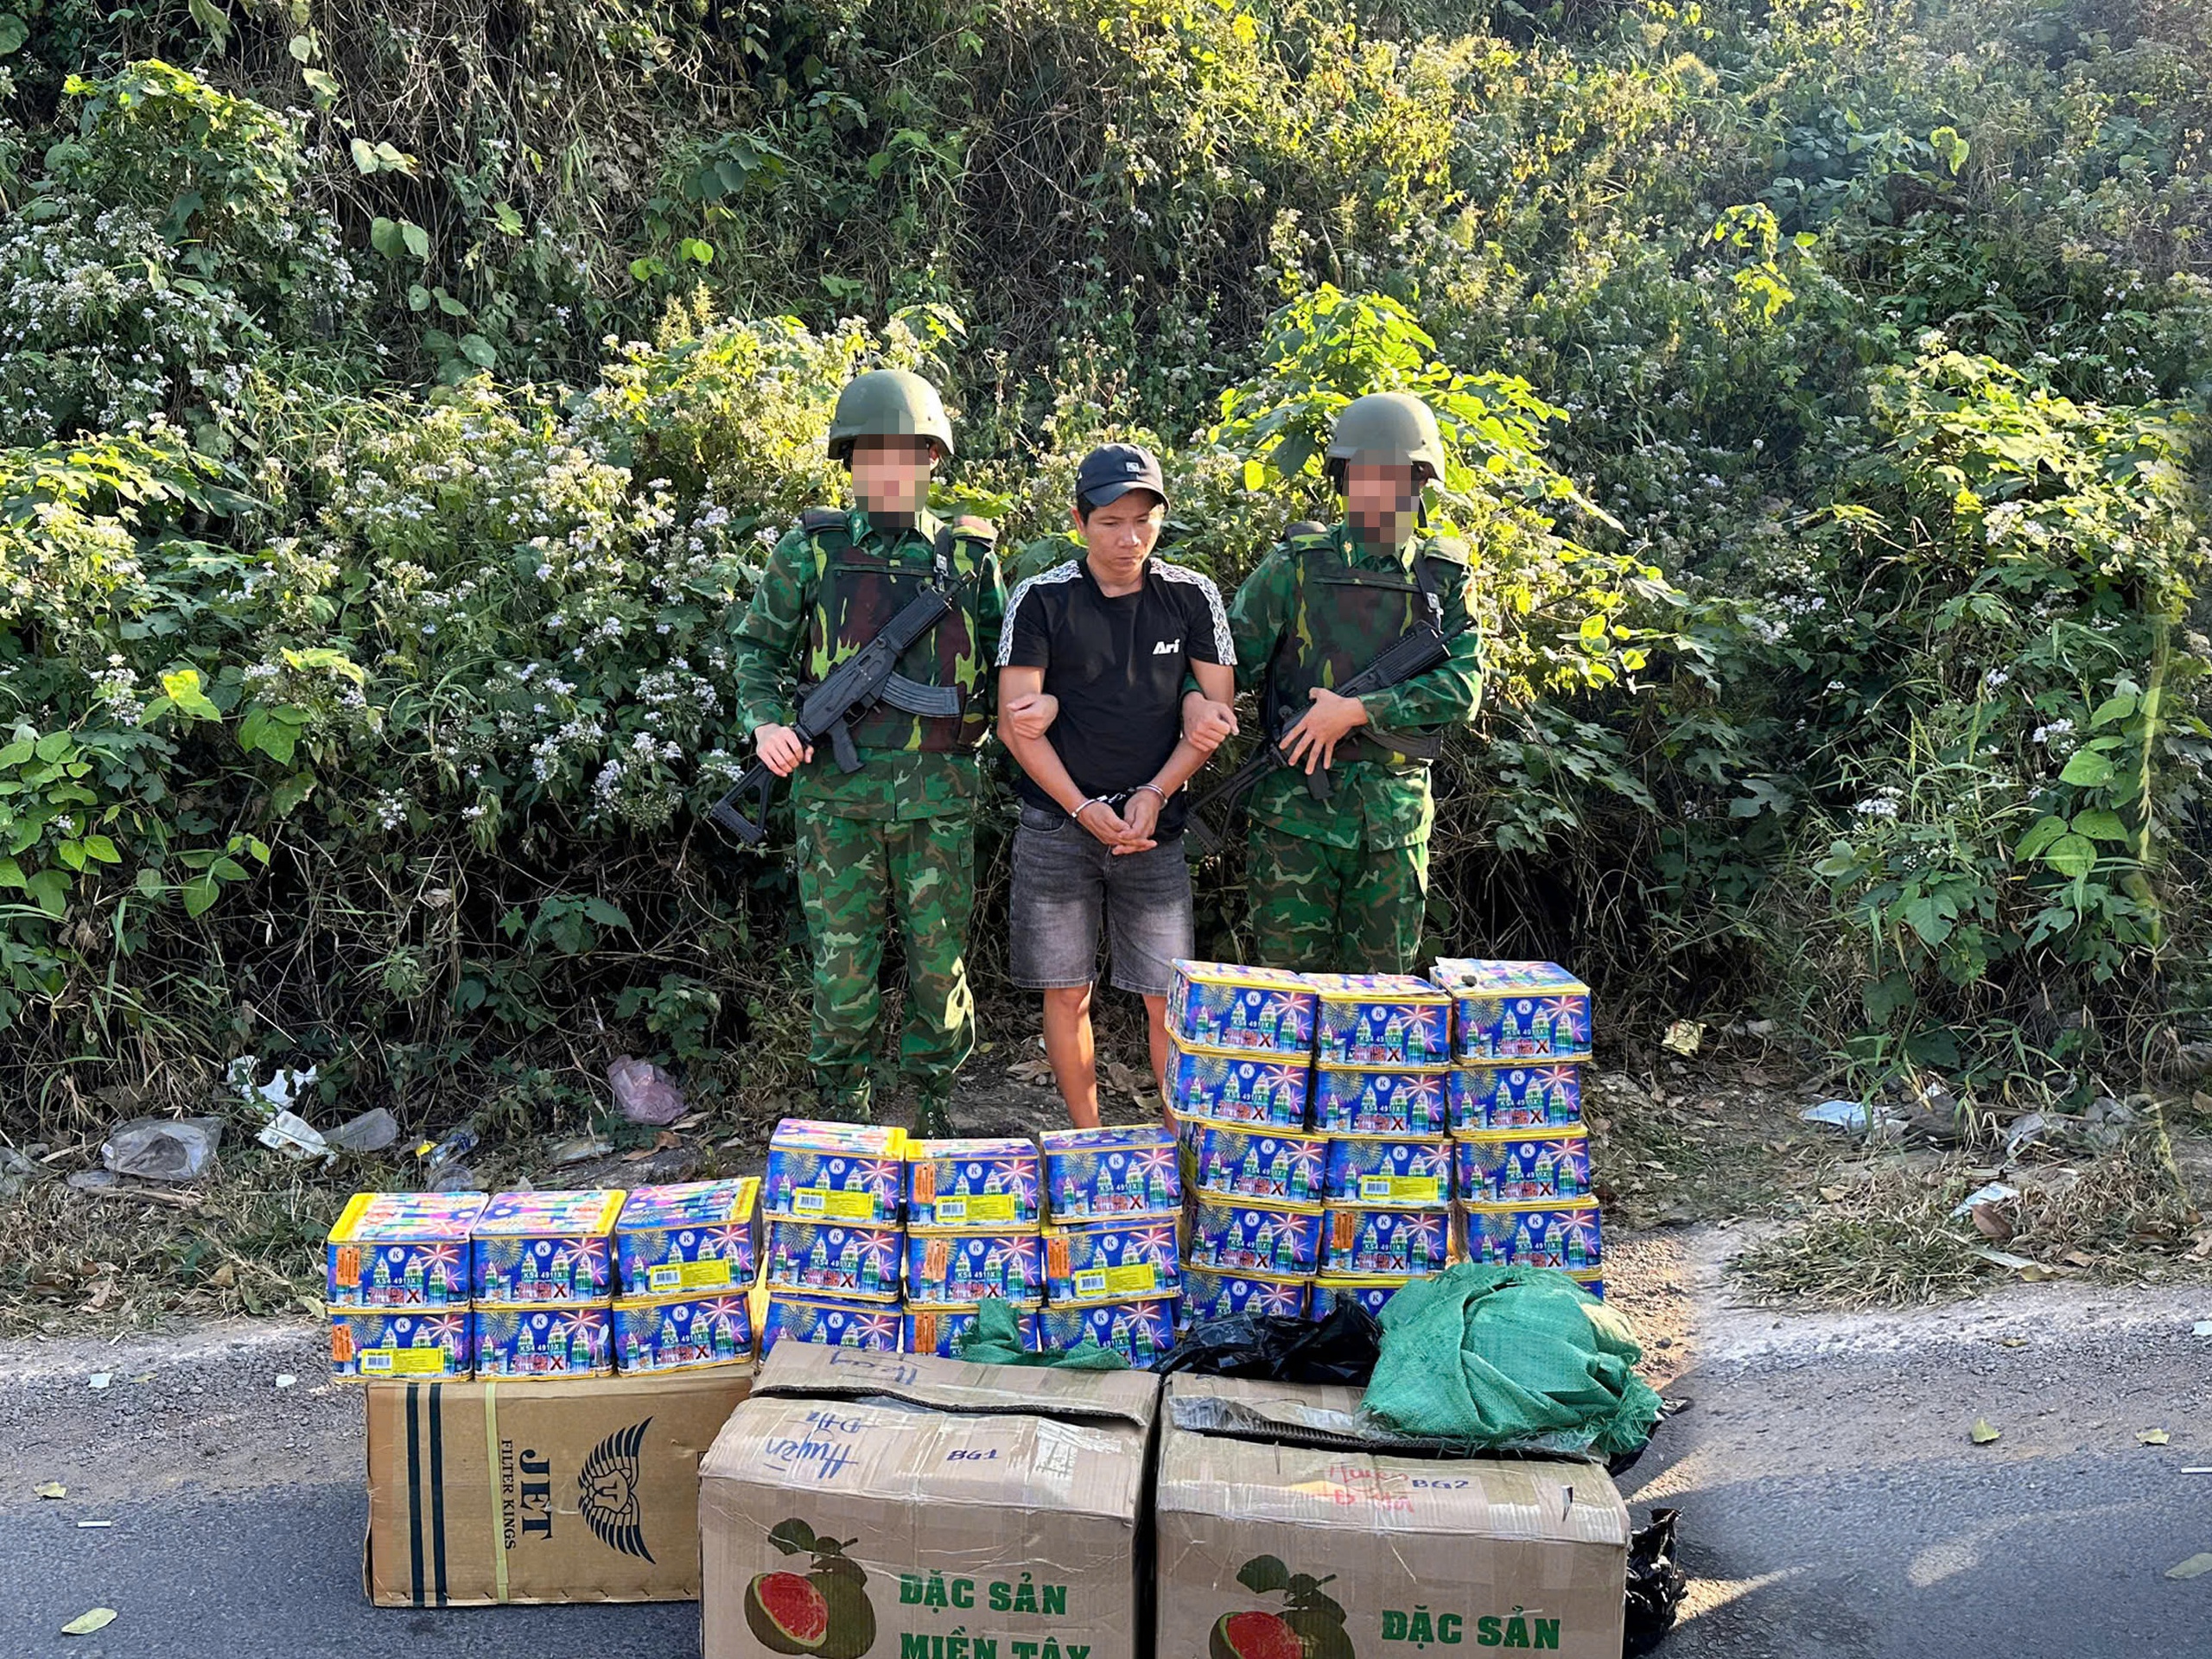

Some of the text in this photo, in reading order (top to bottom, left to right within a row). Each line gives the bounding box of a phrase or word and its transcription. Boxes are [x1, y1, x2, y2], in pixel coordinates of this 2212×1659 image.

[1259, 1032, 1273, 1048] X
[1535, 1039, 1548, 1054] X
[1387, 1046, 1400, 1062] X
[1252, 1104, 1266, 1121] X
[1529, 1109, 1543, 1124] X
[1391, 1116, 1404, 1131] X
[1270, 1179, 1285, 1196] X
[1538, 1181, 1552, 1197] X
[1129, 1193, 1143, 1210] X
[1255, 1252, 1269, 1268] X
[1391, 1255, 1404, 1270] X
[1548, 1252, 1561, 1267] X
[840, 1272, 855, 1288] X
[406, 1287, 420, 1303] X
[554, 1282, 567, 1298] X
[987, 1282, 1000, 1298] X
[695, 1343, 709, 1360] X
[550, 1354, 563, 1370] X
[946, 1448, 1001, 1462] BG1
[1412, 1478, 1469, 1490] BG2
[501, 1440, 517, 1549] FILTER KINGS
[519, 1449, 553, 1540] JET
[899, 1569, 1067, 1616] ĐẶC SẢN
[1382, 1605, 1560, 1650] ĐẶC SẢN
[900, 1625, 997, 1659] MIỀN
